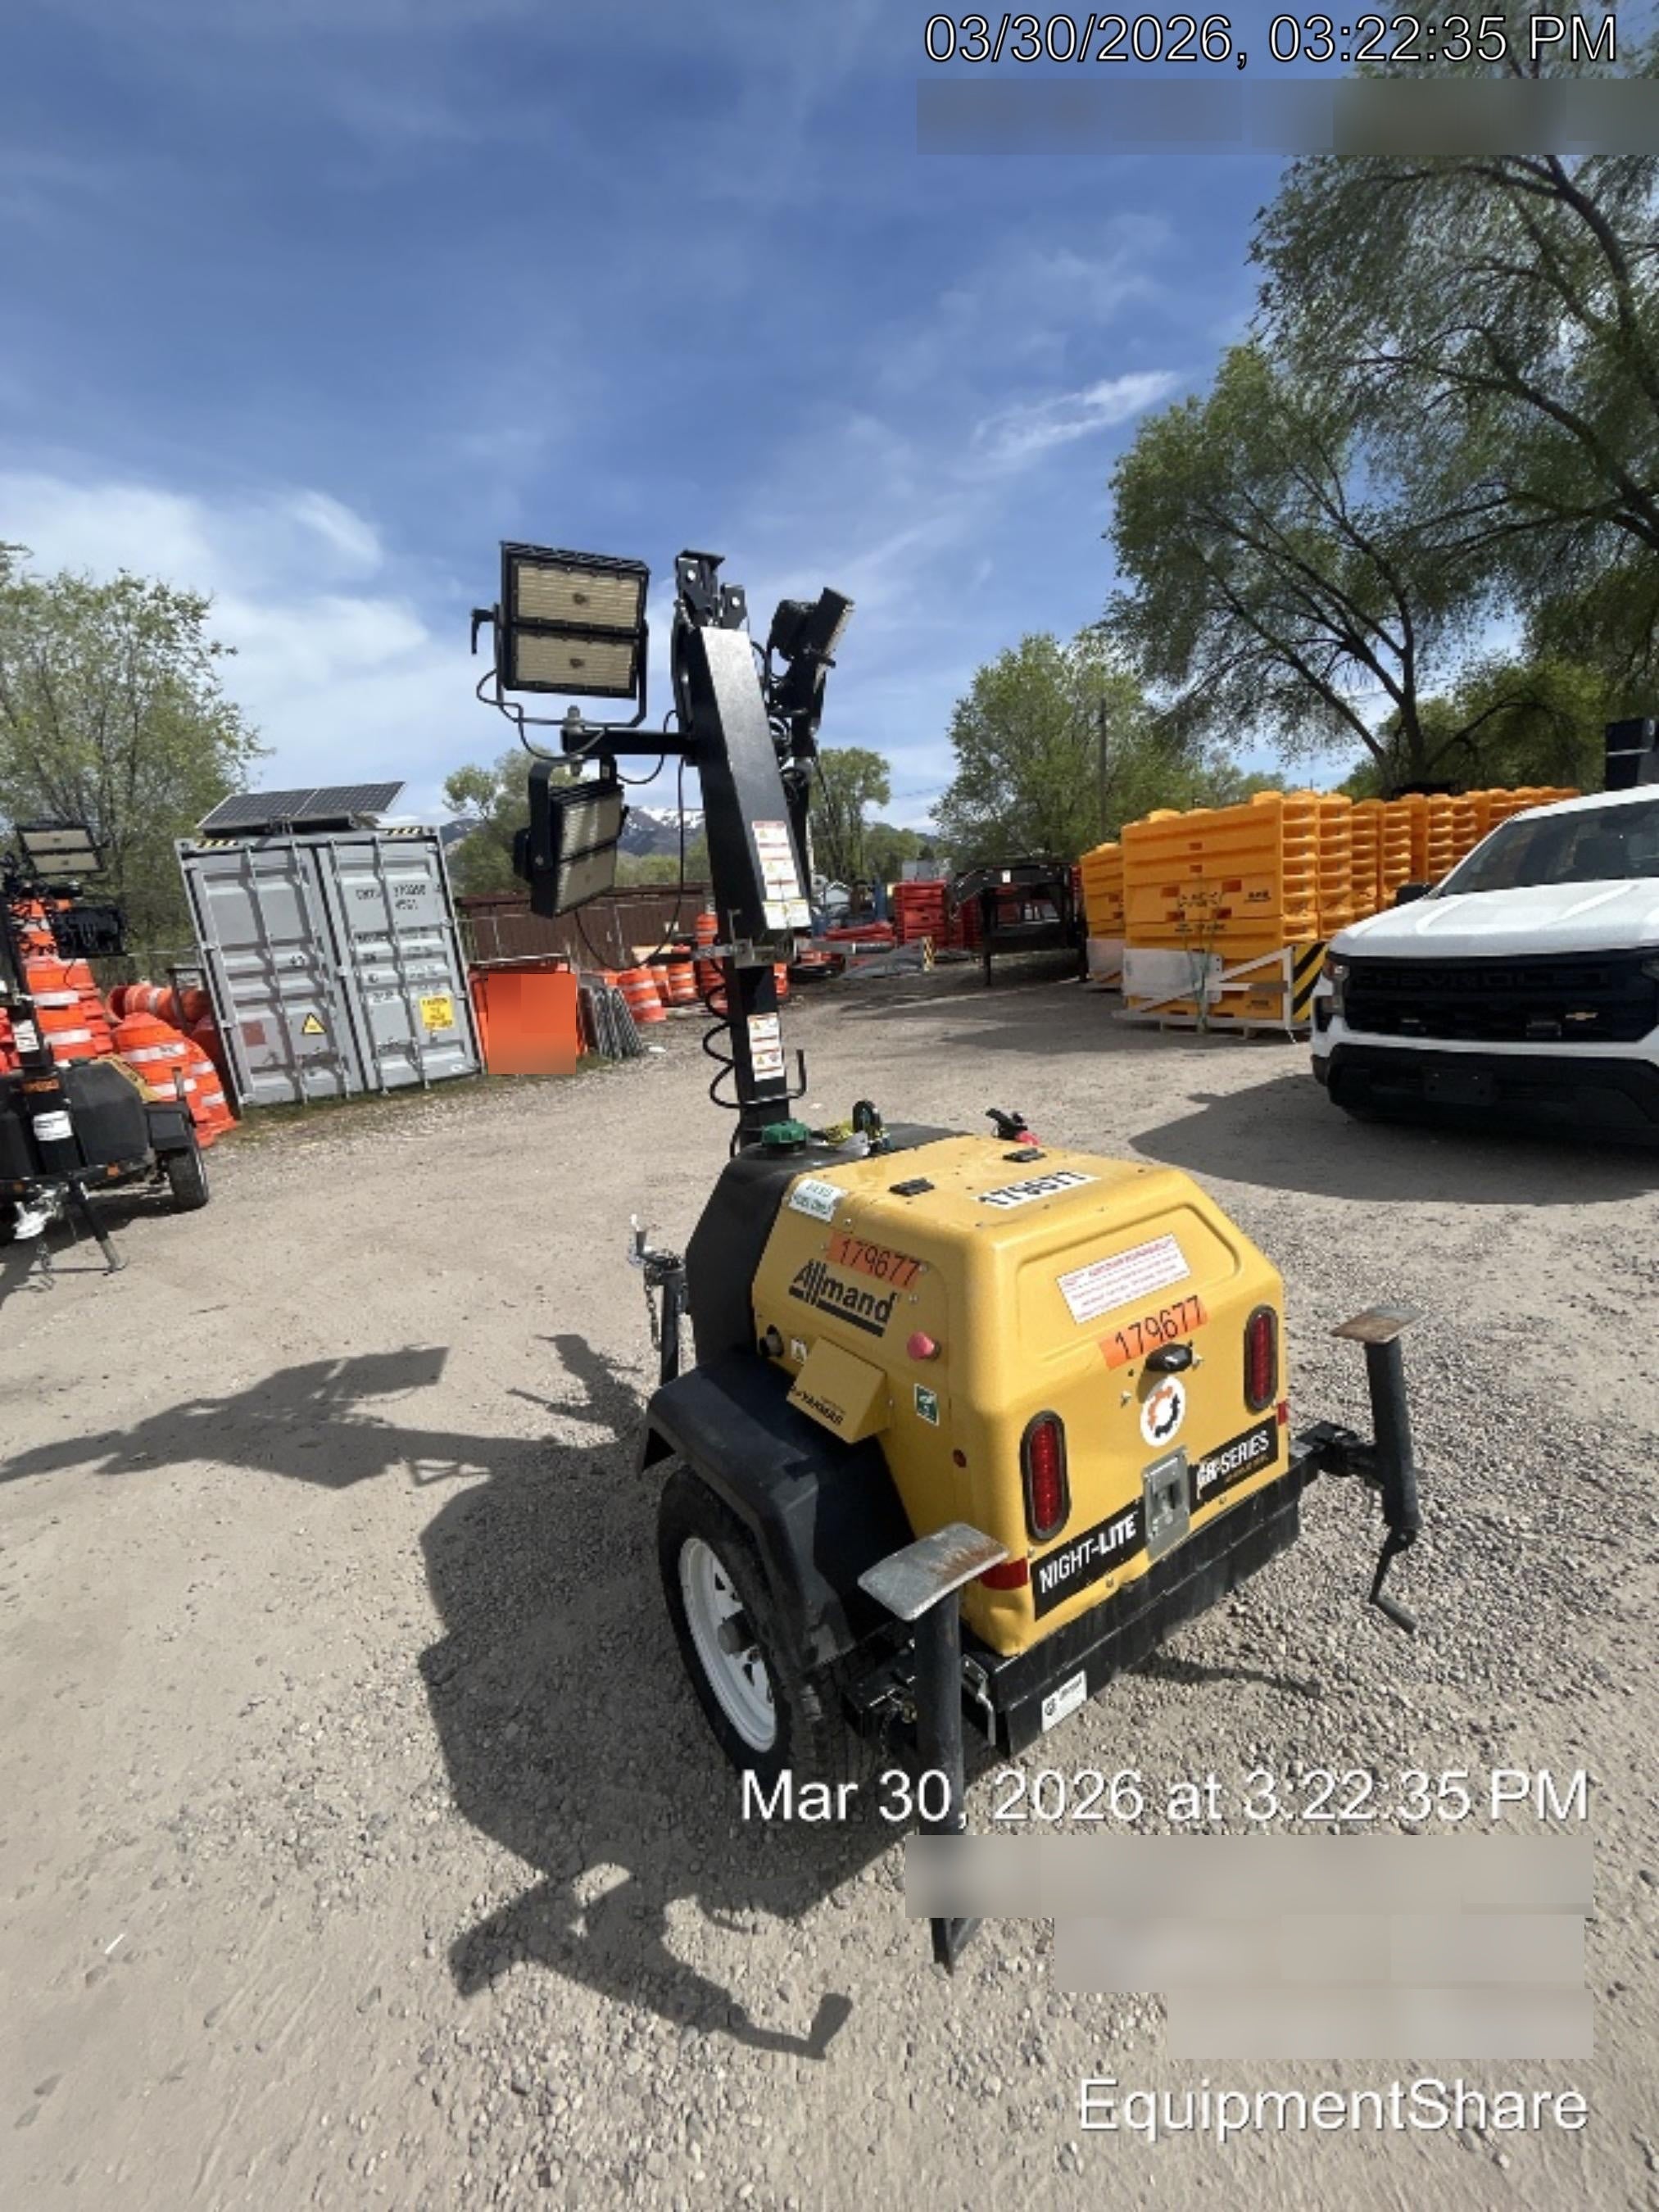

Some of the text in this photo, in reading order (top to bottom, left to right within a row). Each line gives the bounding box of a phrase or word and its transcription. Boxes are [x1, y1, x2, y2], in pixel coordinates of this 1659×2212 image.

[979, 1172, 1086, 1204] 179677
[792, 1258, 898, 1325] Allmand
[841, 1239, 921, 1287] 179677
[1115, 1294, 1202, 1360] 179677
[1038, 1512, 1138, 1593] NIGHT-LITE
